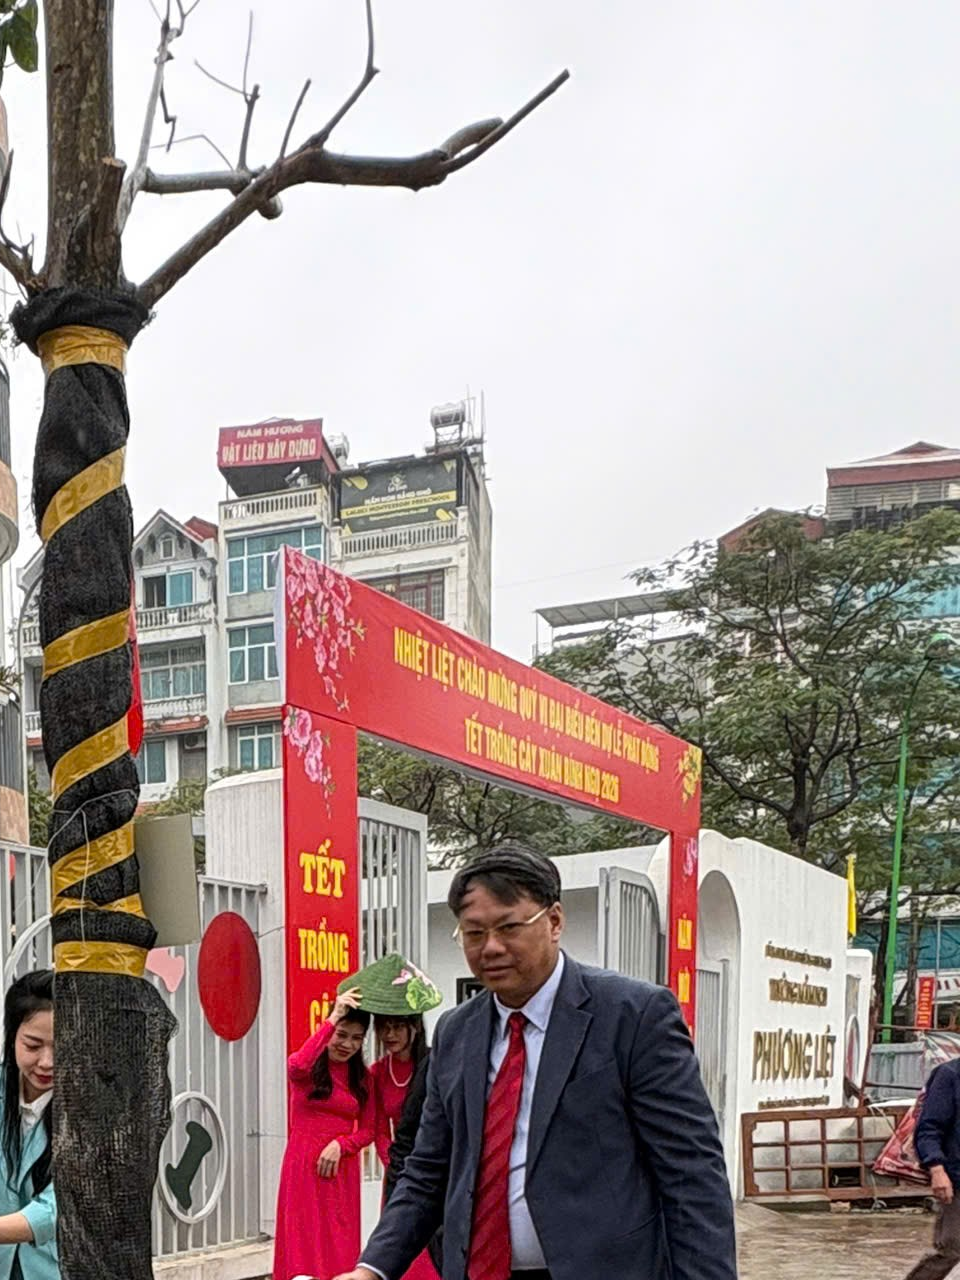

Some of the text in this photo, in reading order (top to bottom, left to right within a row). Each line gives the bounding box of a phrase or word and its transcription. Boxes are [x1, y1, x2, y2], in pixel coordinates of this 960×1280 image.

[266, 438, 287, 459] XÂY
[394, 626, 430, 681] NHIỆT
[431, 641, 456, 692] LIỆT
[457, 655, 486, 701] CHÀO
[487, 667, 517, 714] MỪNG
[519, 684, 538, 721] QUÝ
[465, 711, 483, 757] TẾT
[485, 721, 517, 769] TRỒNG
[519, 735, 537, 775] CÂY
[538, 745, 562, 784] XUÂN
[299, 838, 346, 899] TẾT
[298, 916, 349, 973] TRỒNG
[813, 1023, 837, 1089] LIỆT
